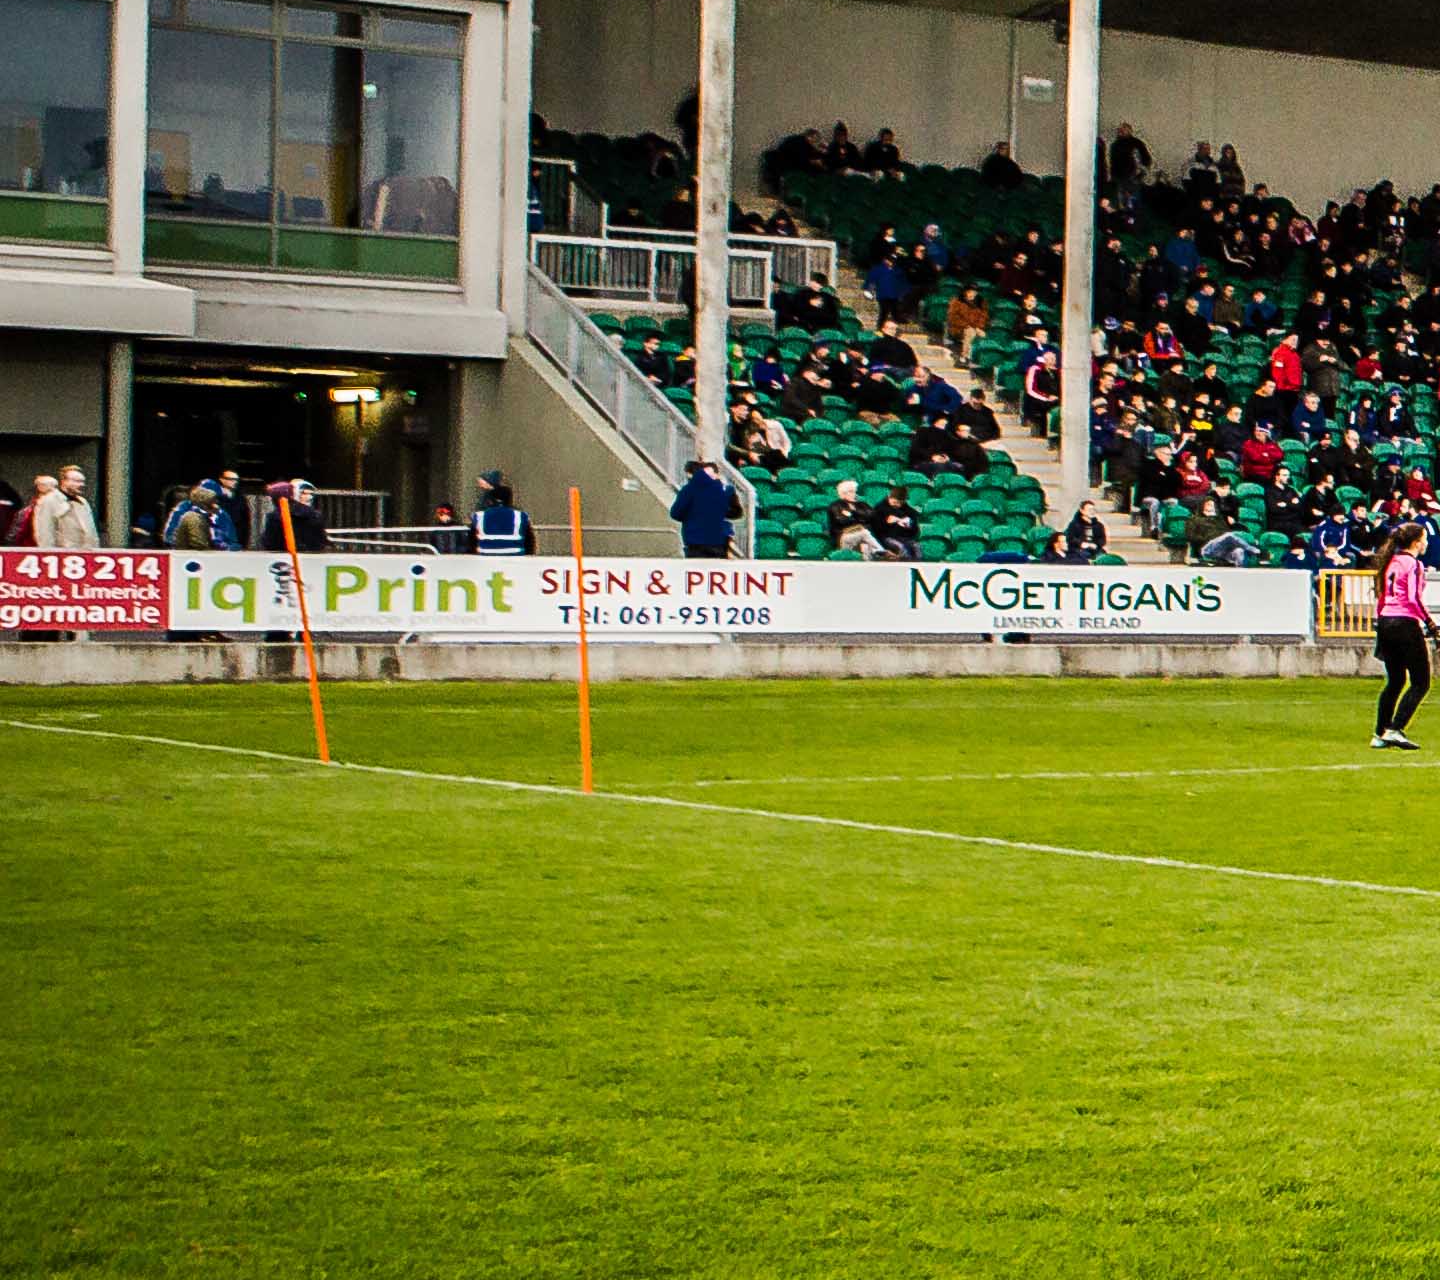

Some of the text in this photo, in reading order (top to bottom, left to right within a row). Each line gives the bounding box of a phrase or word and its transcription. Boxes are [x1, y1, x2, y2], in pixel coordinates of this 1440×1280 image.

[16, 555, 87, 579] 418
[93, 556, 161, 580] 214
[0, 582, 161, 601] Street, Limerick
[185, 561, 256, 623] iq
[325, 564, 513, 613] Print
[541, 569, 793, 597] SIGN & PRINT
[619, 605, 771, 626] 061-951208
[993, 616, 1063, 629] LIMERICK
[1079, 616, 1141, 629] IRELAND
